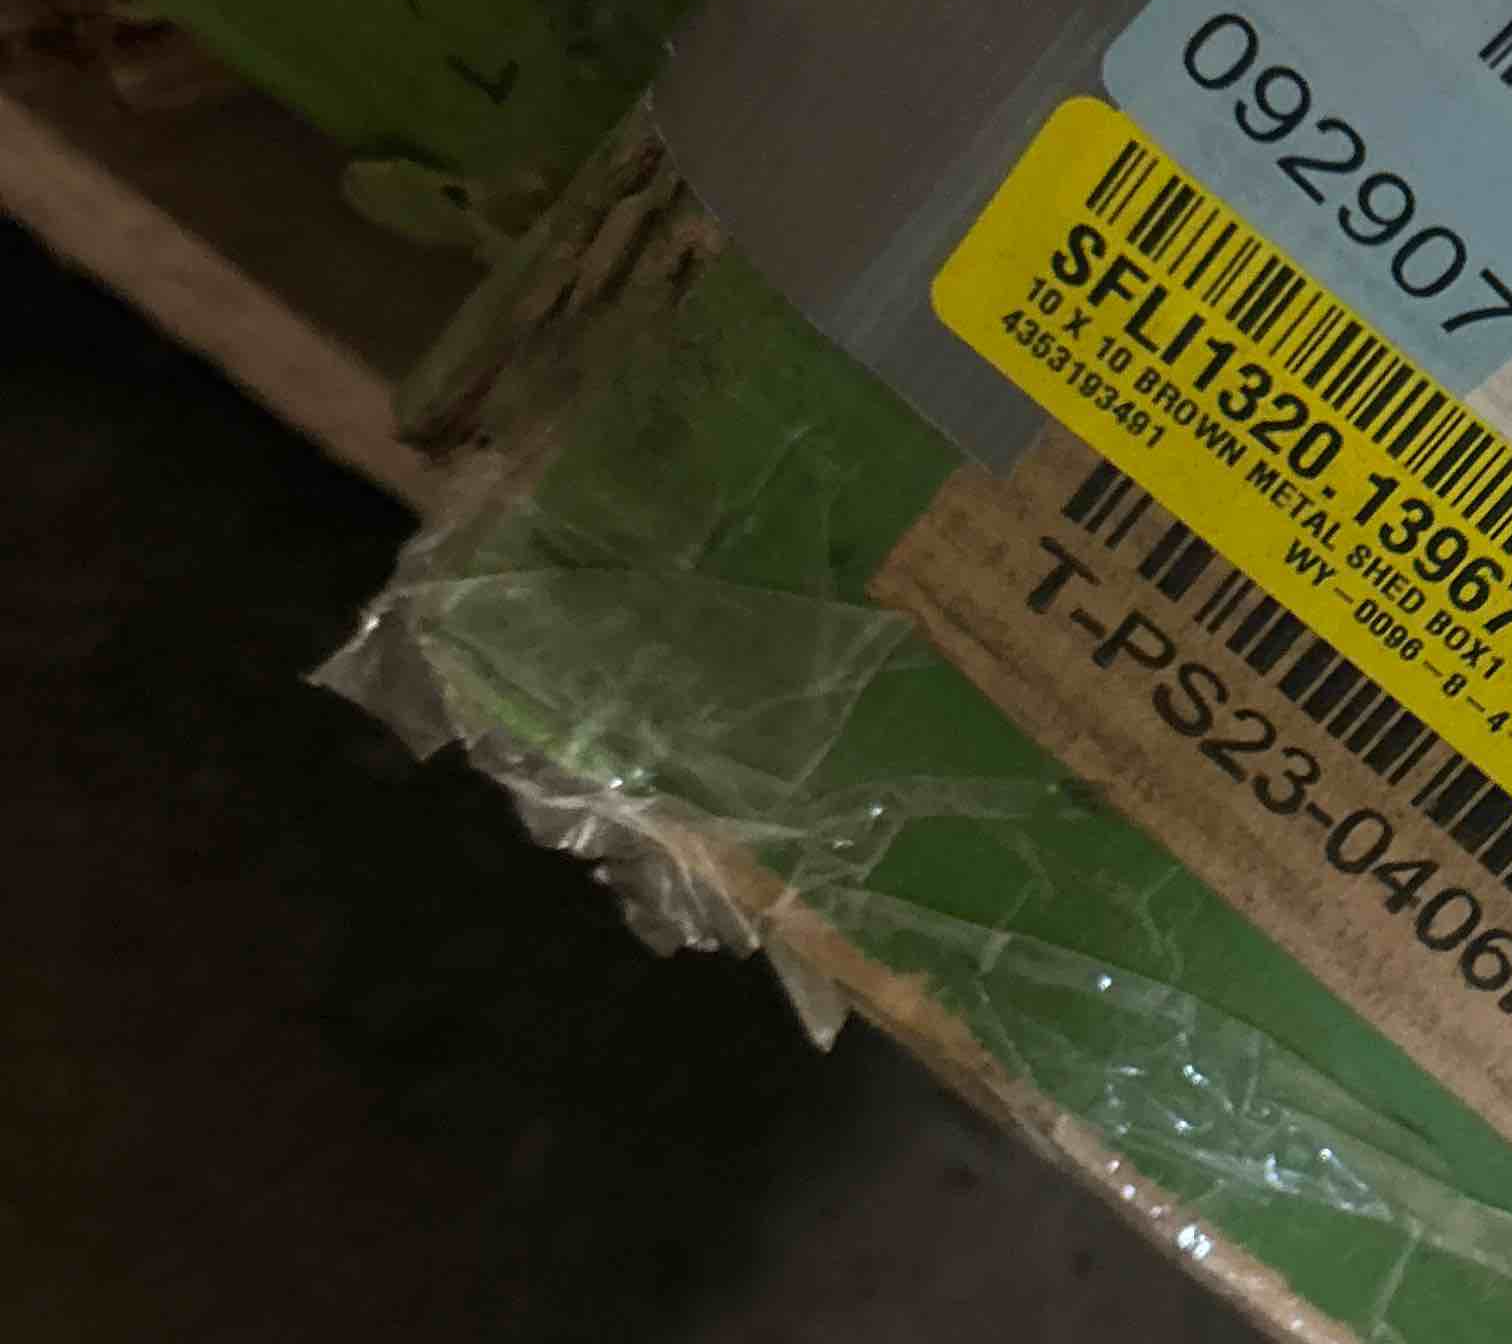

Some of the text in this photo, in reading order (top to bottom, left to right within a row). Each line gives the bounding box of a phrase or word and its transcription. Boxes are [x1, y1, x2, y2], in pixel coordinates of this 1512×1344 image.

[1002, 309, 1166, 449] 4353193491
[1028, 277, 1505, 680] 10 X 10 BROWN METAL SHED BOX1
